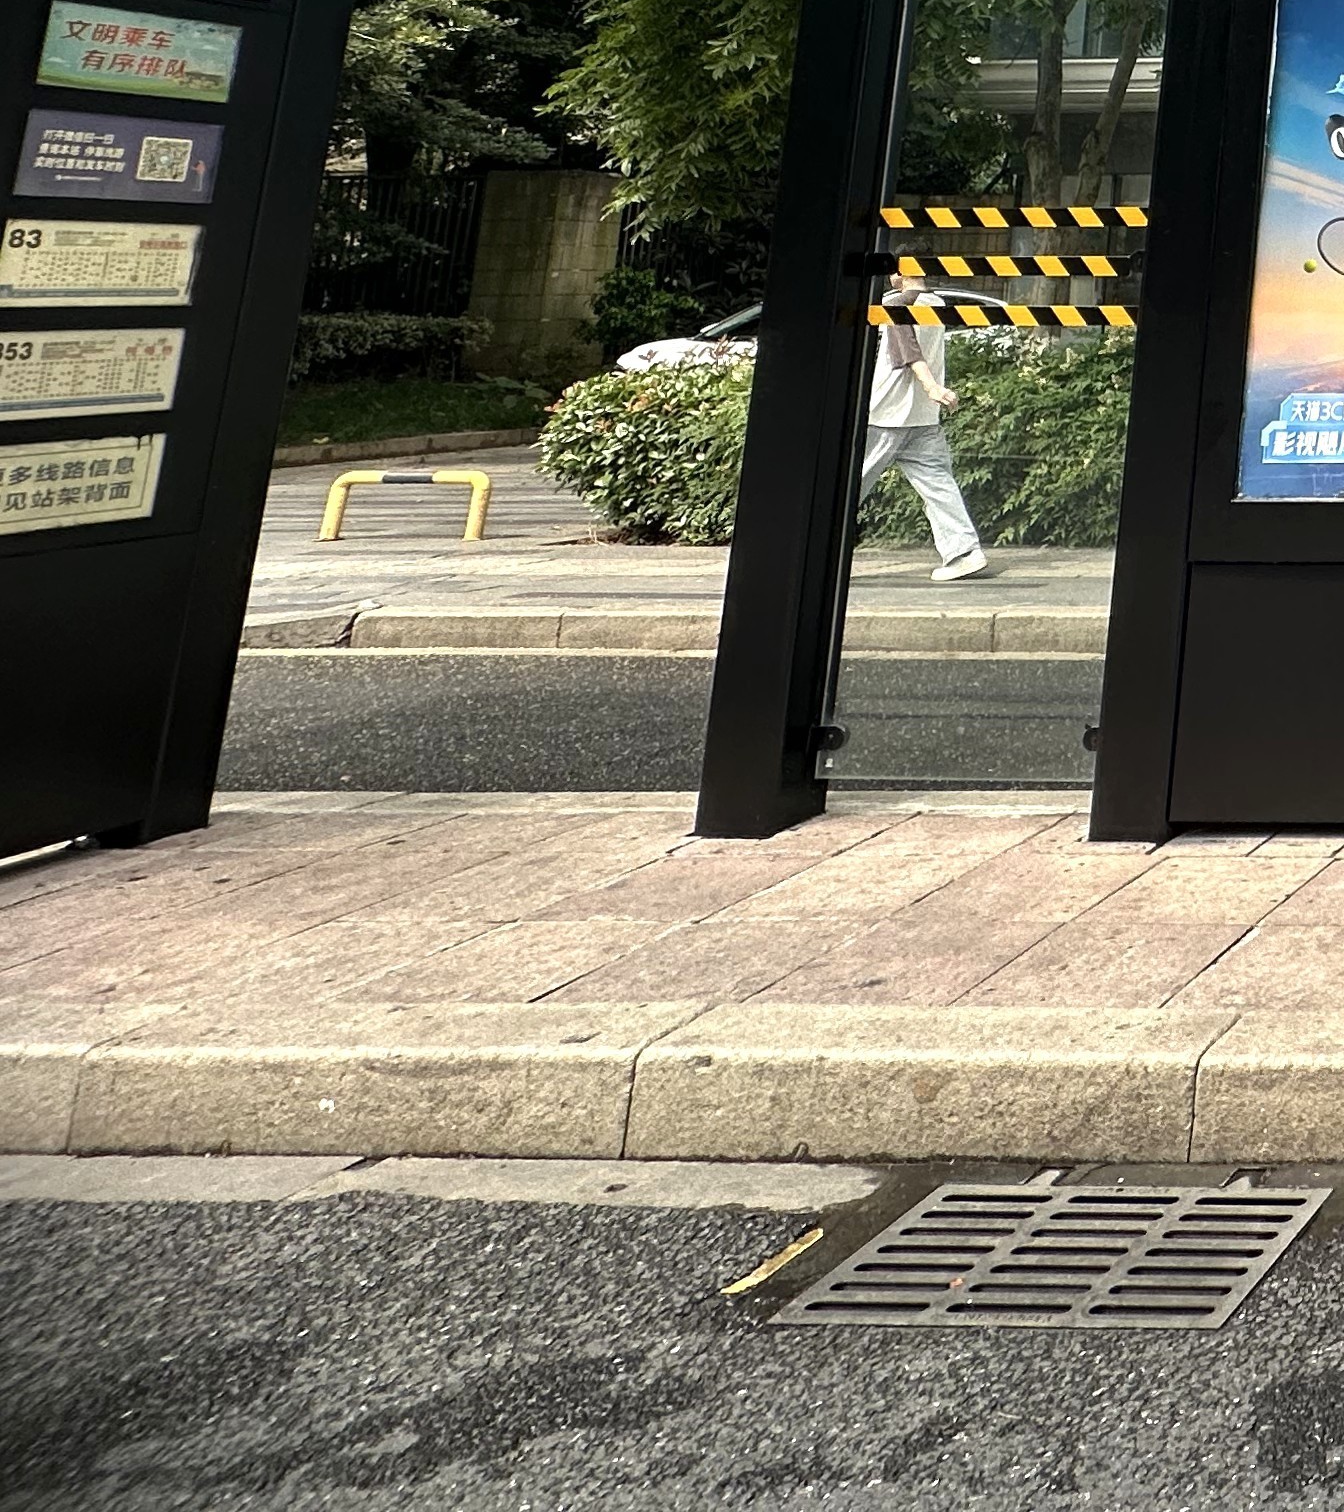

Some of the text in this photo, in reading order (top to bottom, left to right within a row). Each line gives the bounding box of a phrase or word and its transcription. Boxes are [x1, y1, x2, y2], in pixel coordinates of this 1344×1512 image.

[62, 19, 176, 51] 文明乘车
[81, 49, 187, 80] 有序排队
[8, 228, 43, 248] 83
[0, 480, 133, 513] 见站架背面
